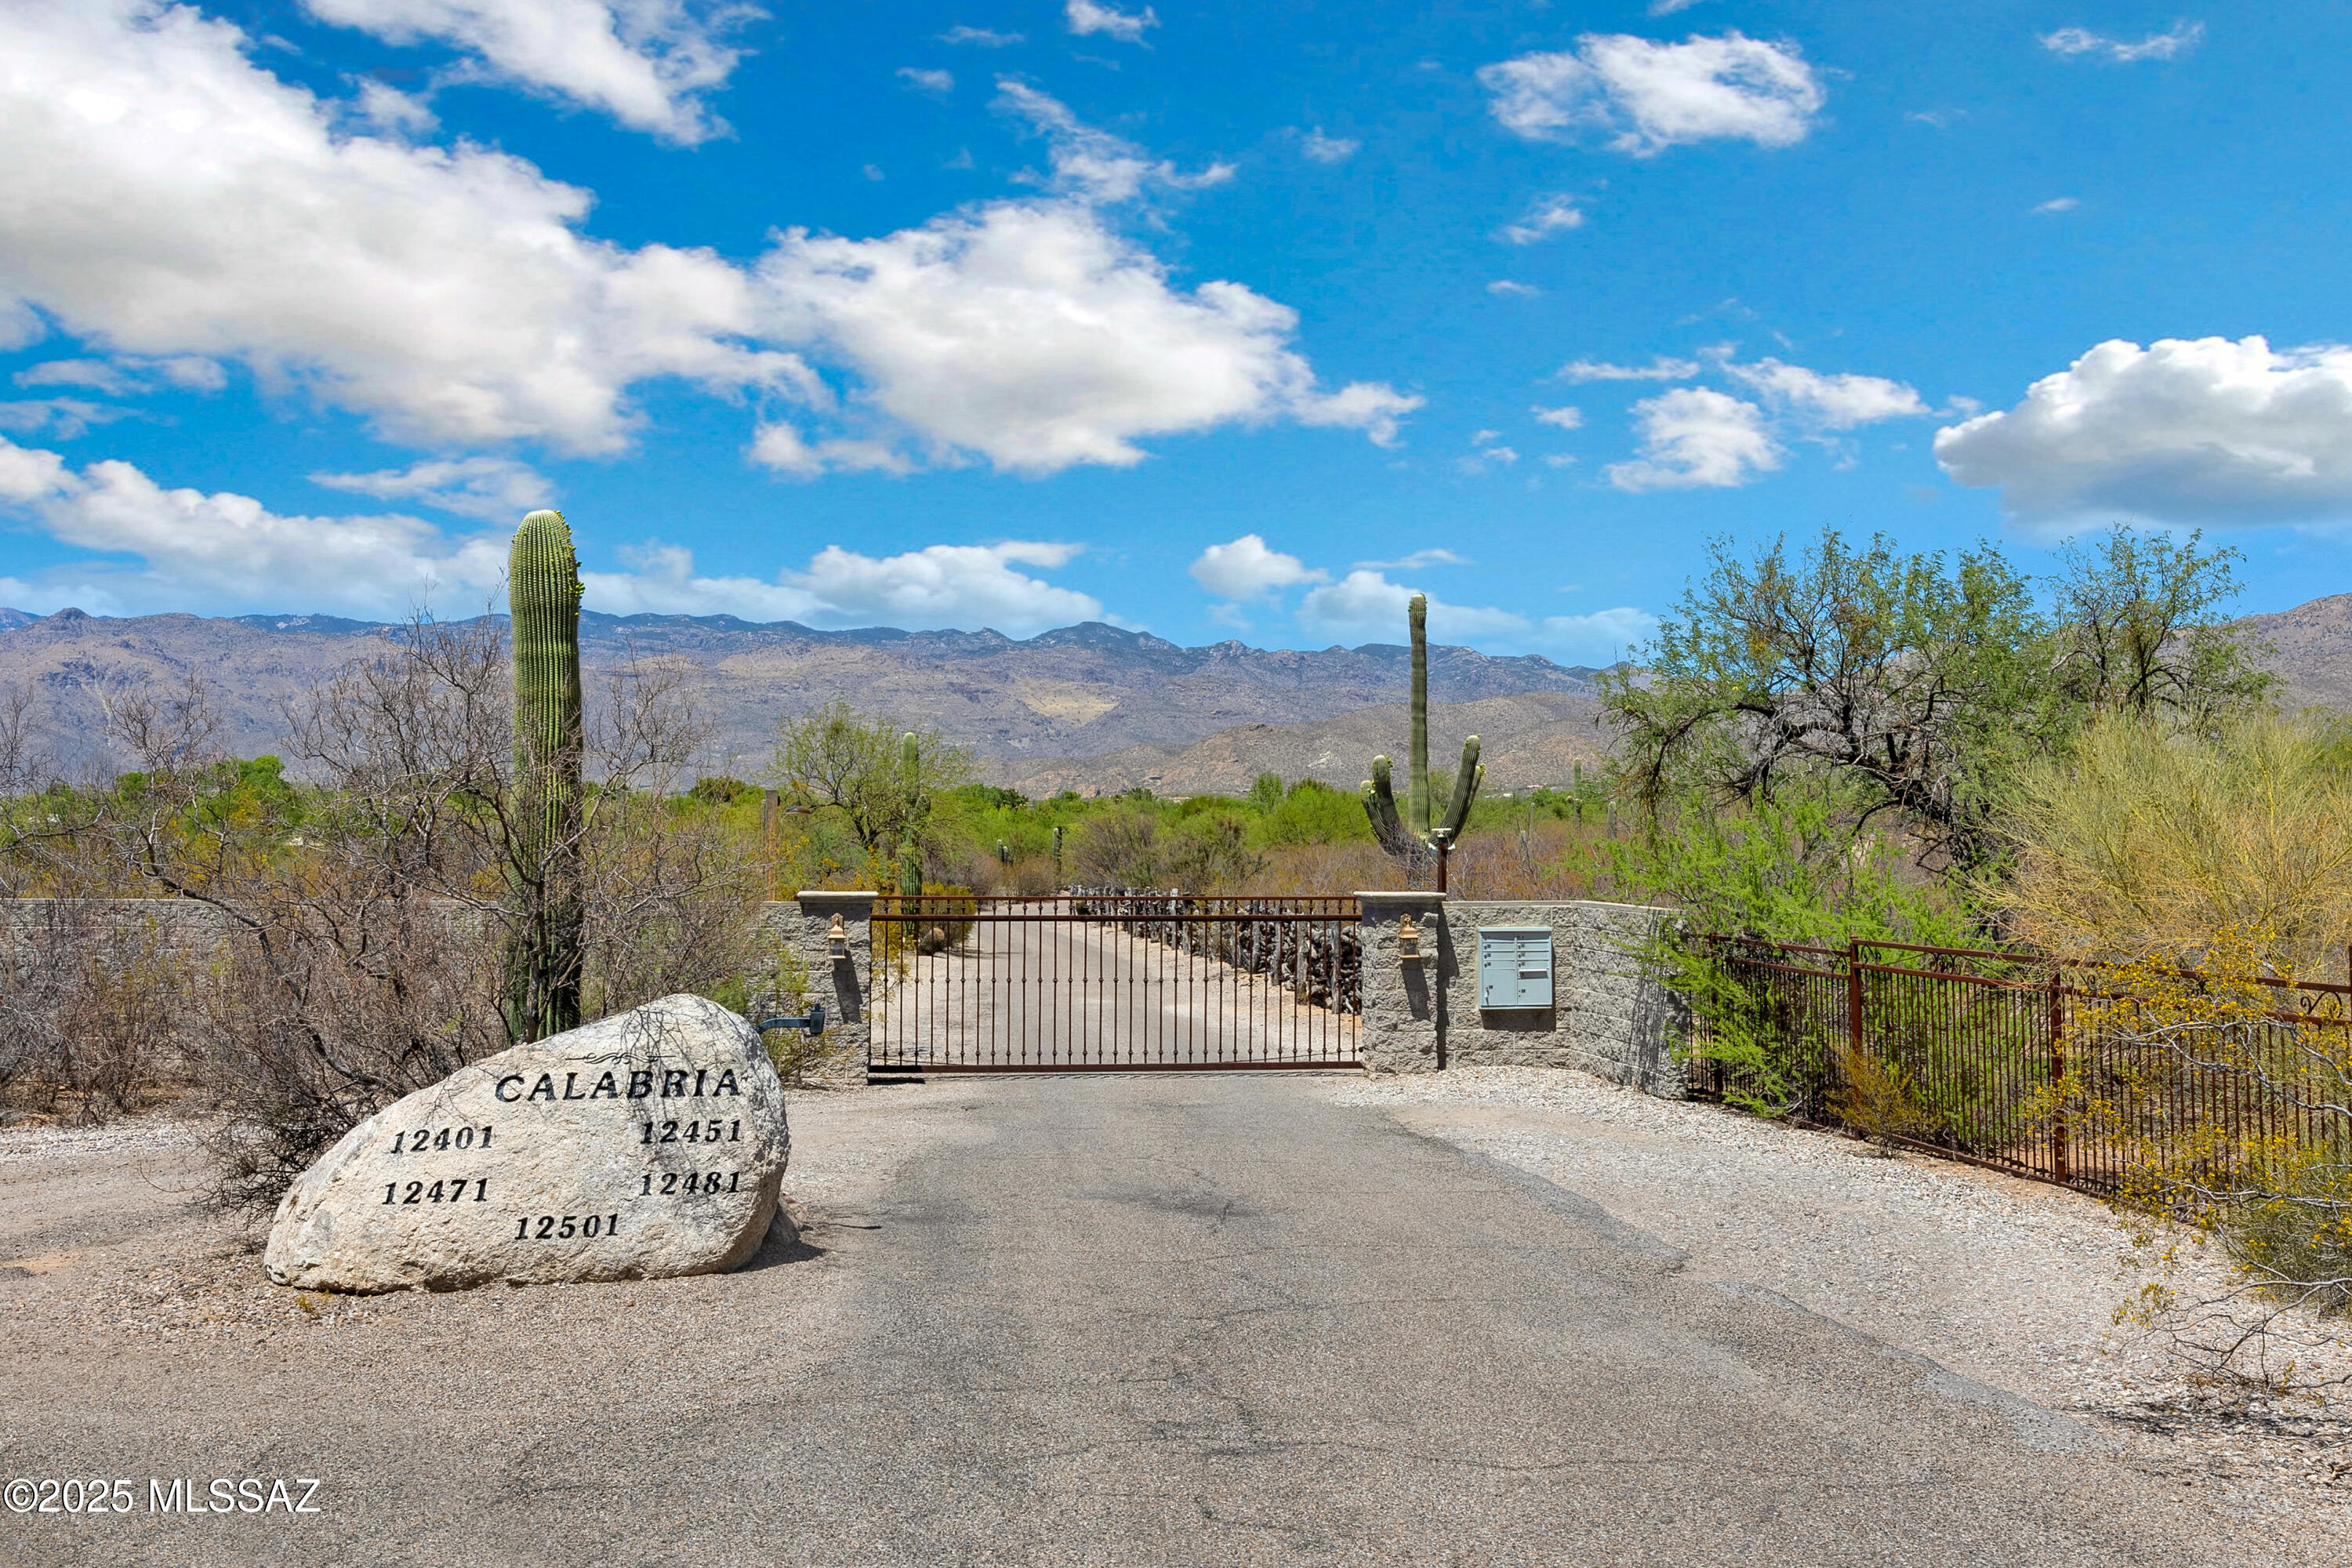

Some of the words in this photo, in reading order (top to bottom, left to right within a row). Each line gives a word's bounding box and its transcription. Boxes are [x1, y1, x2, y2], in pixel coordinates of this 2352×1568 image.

[495, 1069, 739, 1102] CALABRIA
[391, 1125, 493, 1153] 12401
[641, 1119, 741, 1145] 12451
[383, 1178, 488, 1205] 12471
[640, 1171, 740, 1196] 12481
[515, 1213, 619, 1240] 12501
